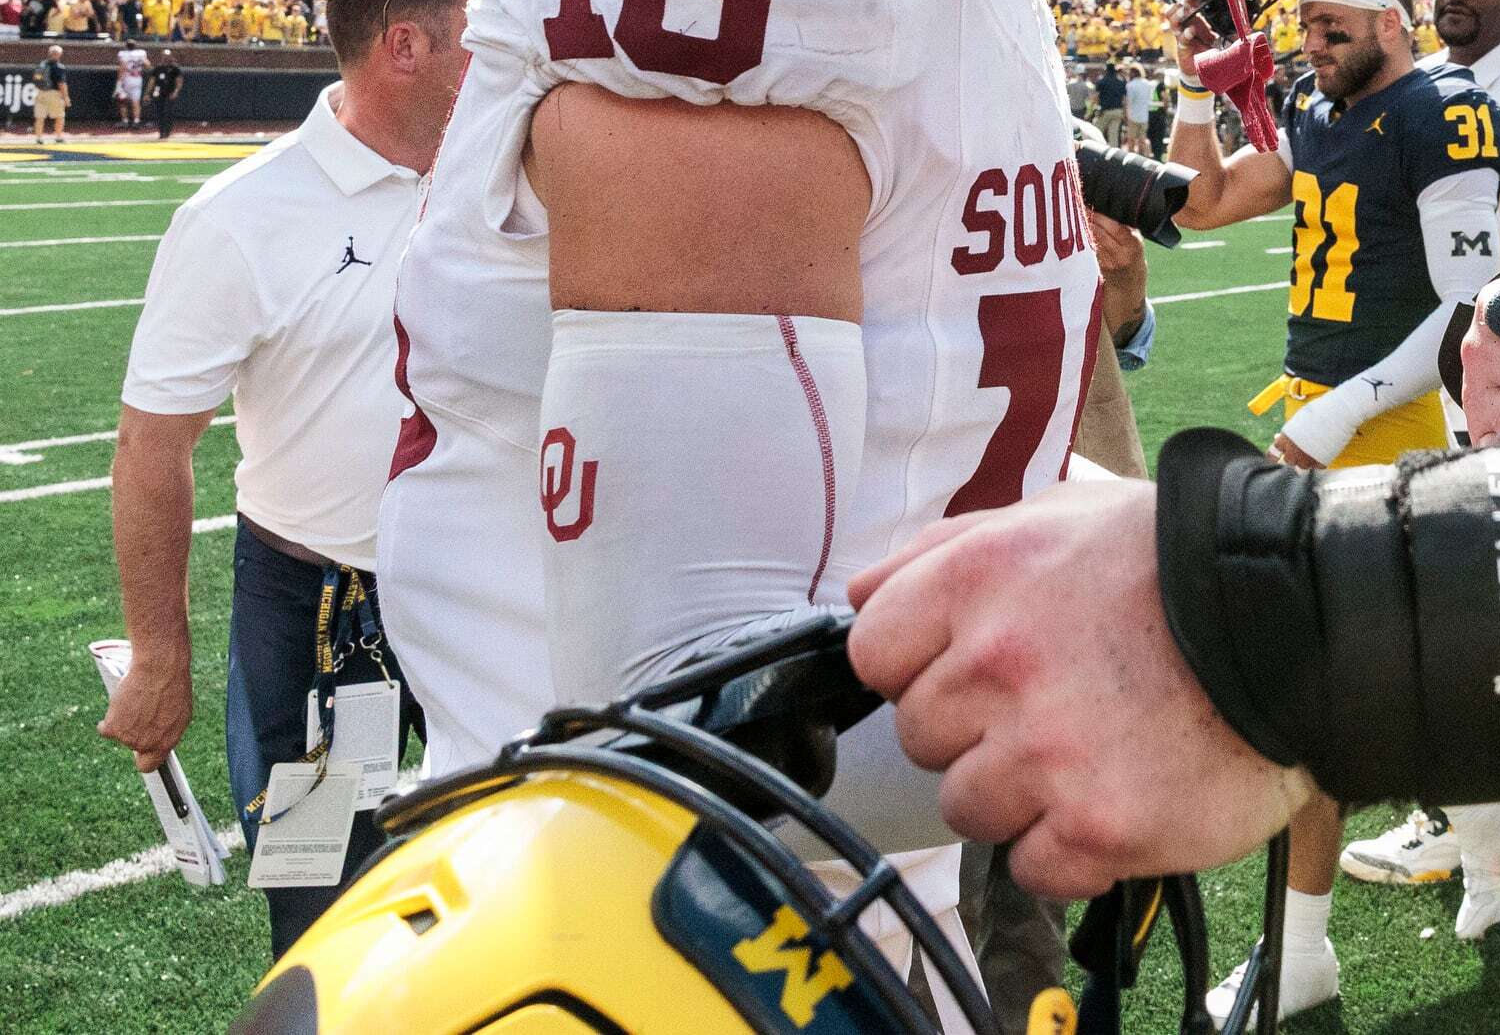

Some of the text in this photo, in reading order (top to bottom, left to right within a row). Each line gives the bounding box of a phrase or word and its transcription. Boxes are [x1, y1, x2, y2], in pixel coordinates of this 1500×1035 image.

[1444, 104, 1499, 160] 31
[1288, 170, 1360, 322] 31
[1451, 231, 1492, 257] M
[943, 275, 1103, 518] 1
[540, 427, 599, 543] OU
[731, 903, 855, 1028] M
